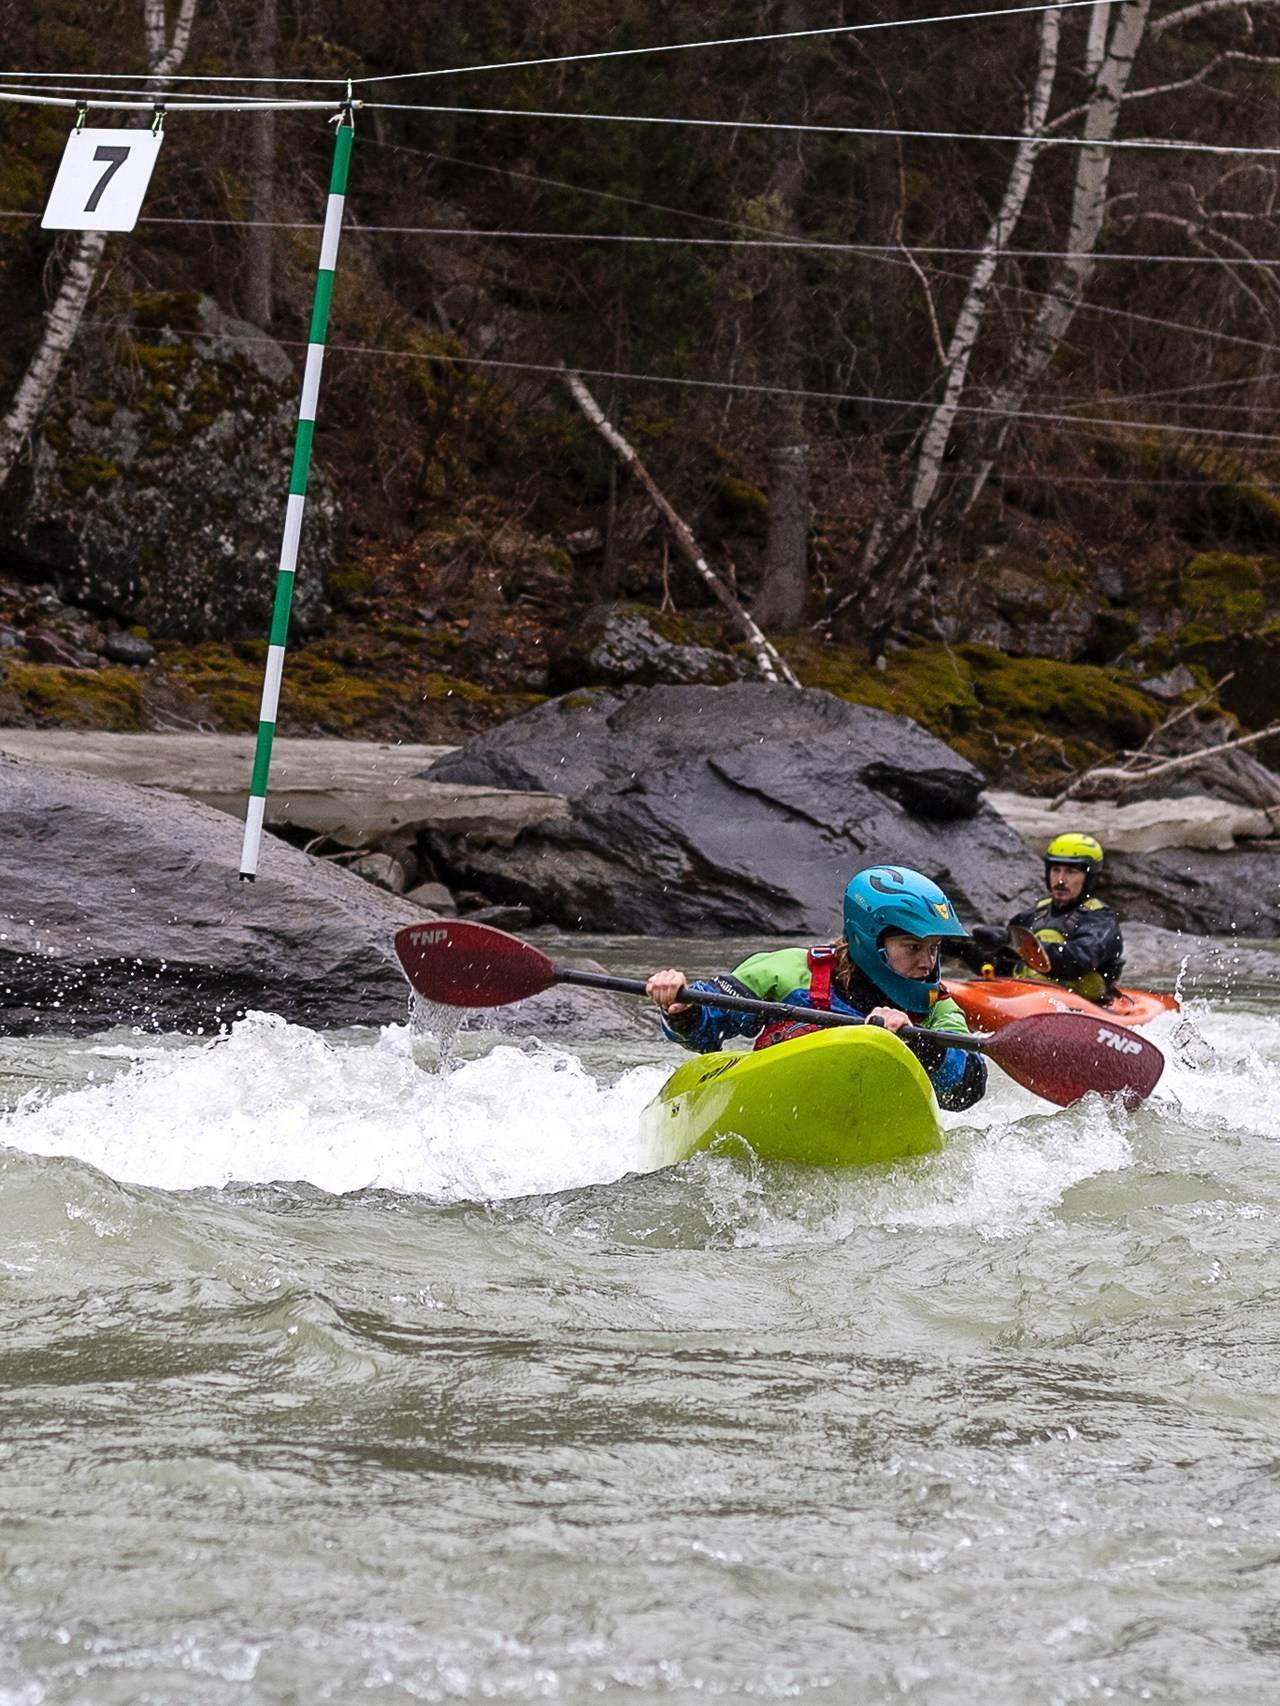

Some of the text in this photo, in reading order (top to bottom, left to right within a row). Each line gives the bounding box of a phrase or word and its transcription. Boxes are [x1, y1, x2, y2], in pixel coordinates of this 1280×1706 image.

[83, 145, 132, 212] 7
[410, 929, 448, 946] TNP
[1096, 1028, 1143, 1055] TNP
